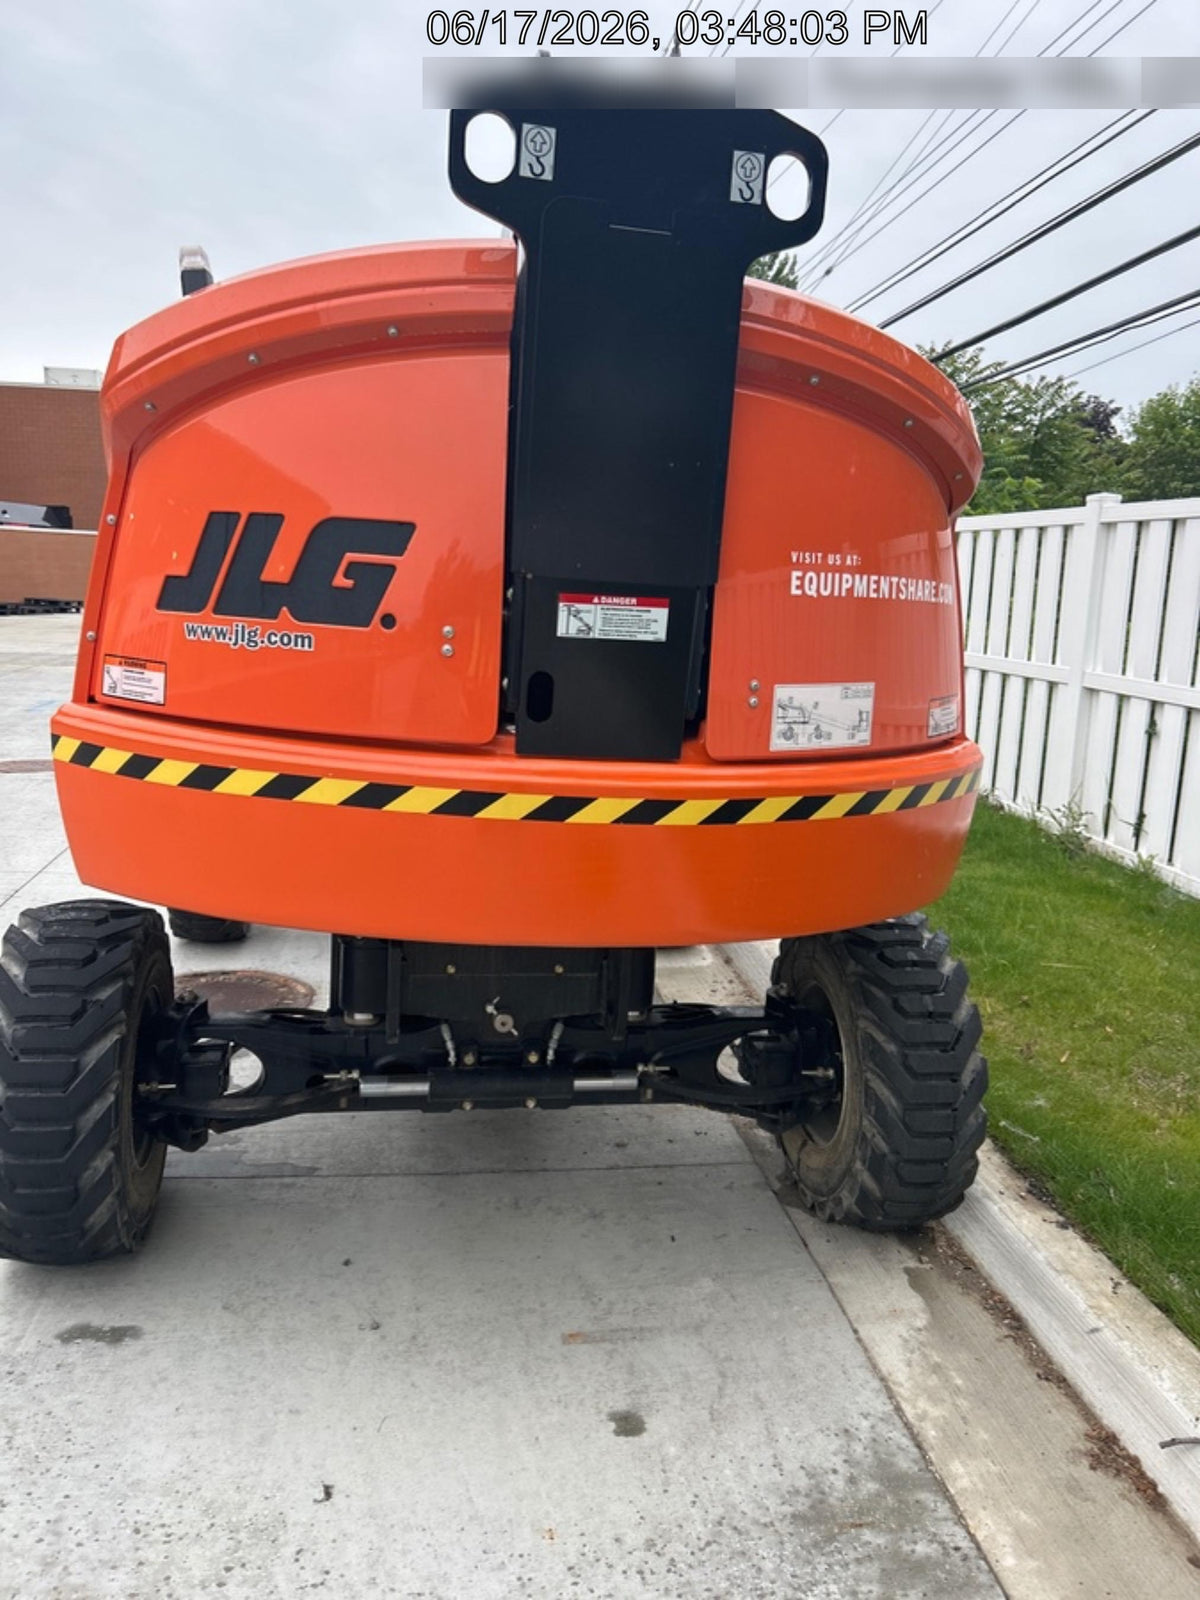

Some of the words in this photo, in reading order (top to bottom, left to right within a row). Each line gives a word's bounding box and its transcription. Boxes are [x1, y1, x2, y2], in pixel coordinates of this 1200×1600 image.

[791, 551, 823, 564] VISIT
[828, 553, 842, 565] US
[845, 555, 862, 566] AT:
[600, 596, 637, 605] DANGER
[185, 622, 314, 649] www.jlg.com
